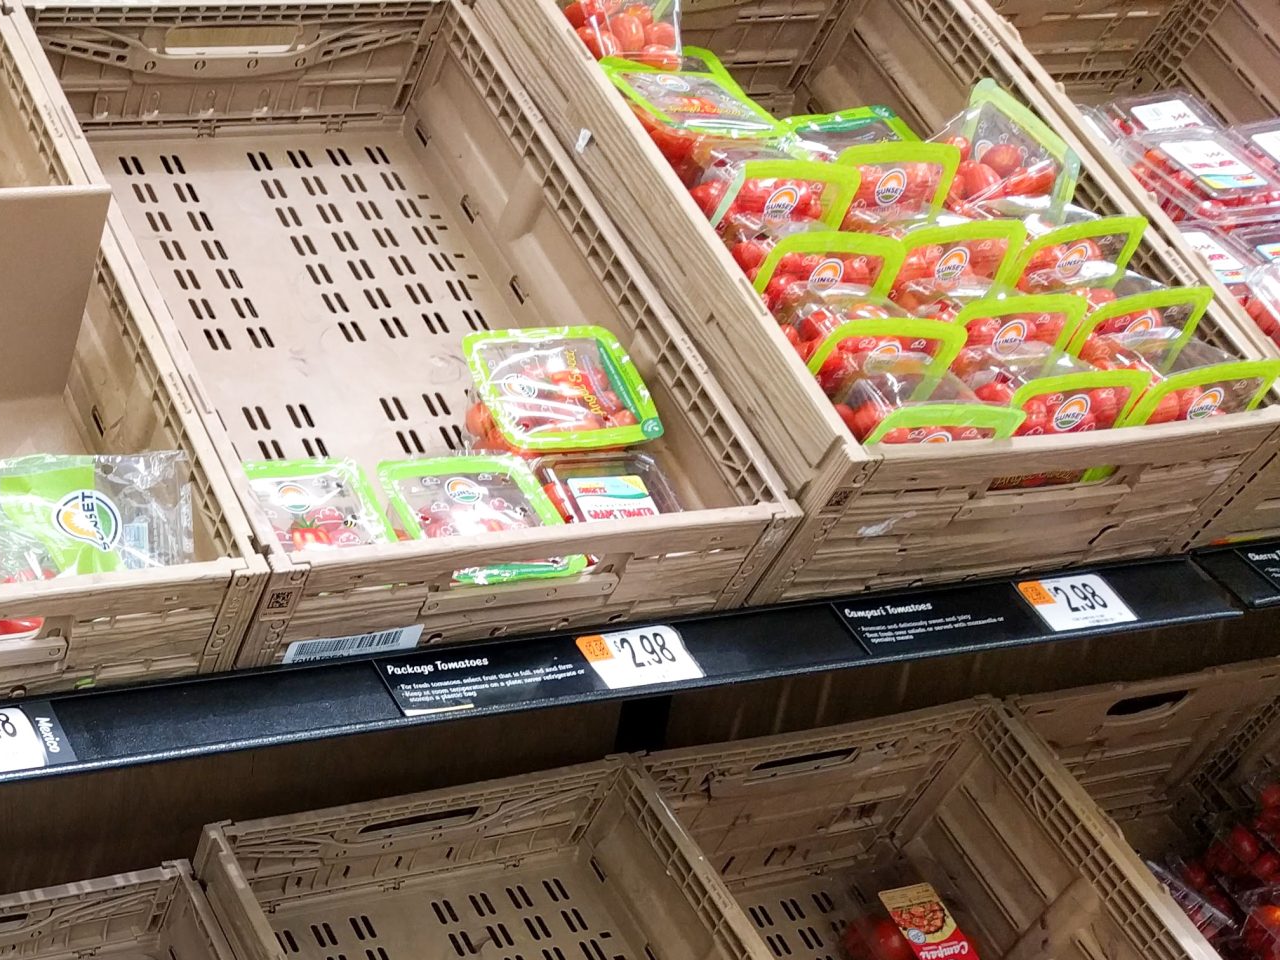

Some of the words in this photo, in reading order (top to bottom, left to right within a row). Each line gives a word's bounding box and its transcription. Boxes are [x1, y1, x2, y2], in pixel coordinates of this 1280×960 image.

[1055, 414, 1084, 423] SUNSET
[1189, 406, 1217, 416] SUNSET
[82, 491, 110, 550] SUNSET
[844, 602, 886, 619] Campari
[884, 602, 933, 615] Tomatoes
[387, 661, 435, 675] Package
[435, 657, 489, 671] Tomatoes
[35, 716, 61, 753] Mexico
